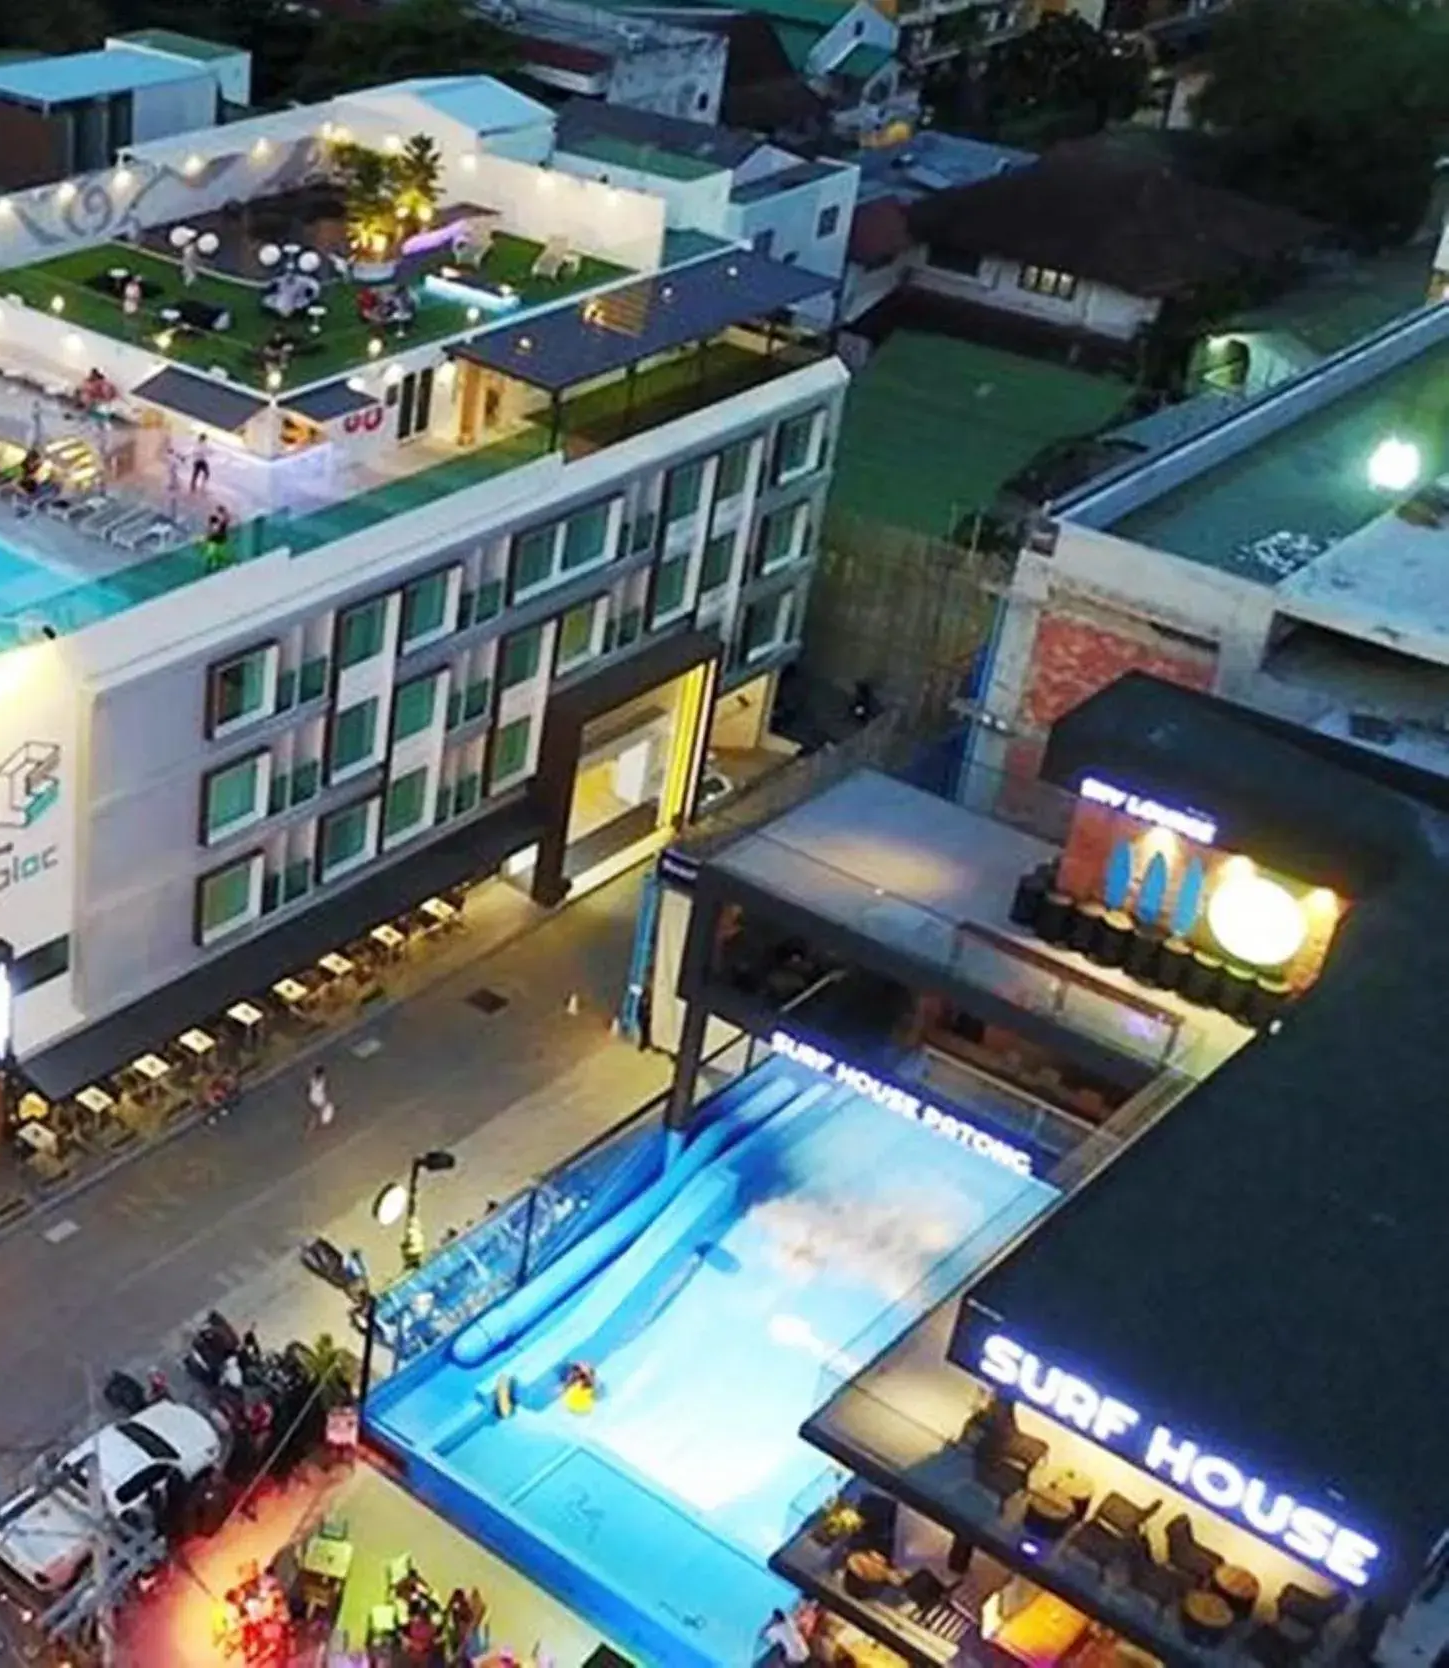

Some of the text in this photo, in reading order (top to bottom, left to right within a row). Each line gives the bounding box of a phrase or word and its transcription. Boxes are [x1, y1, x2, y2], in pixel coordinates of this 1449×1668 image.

[771, 1029, 1033, 1178] SURF HOUSE PATONG
[979, 1333, 1380, 1588] SURF HOUSE
